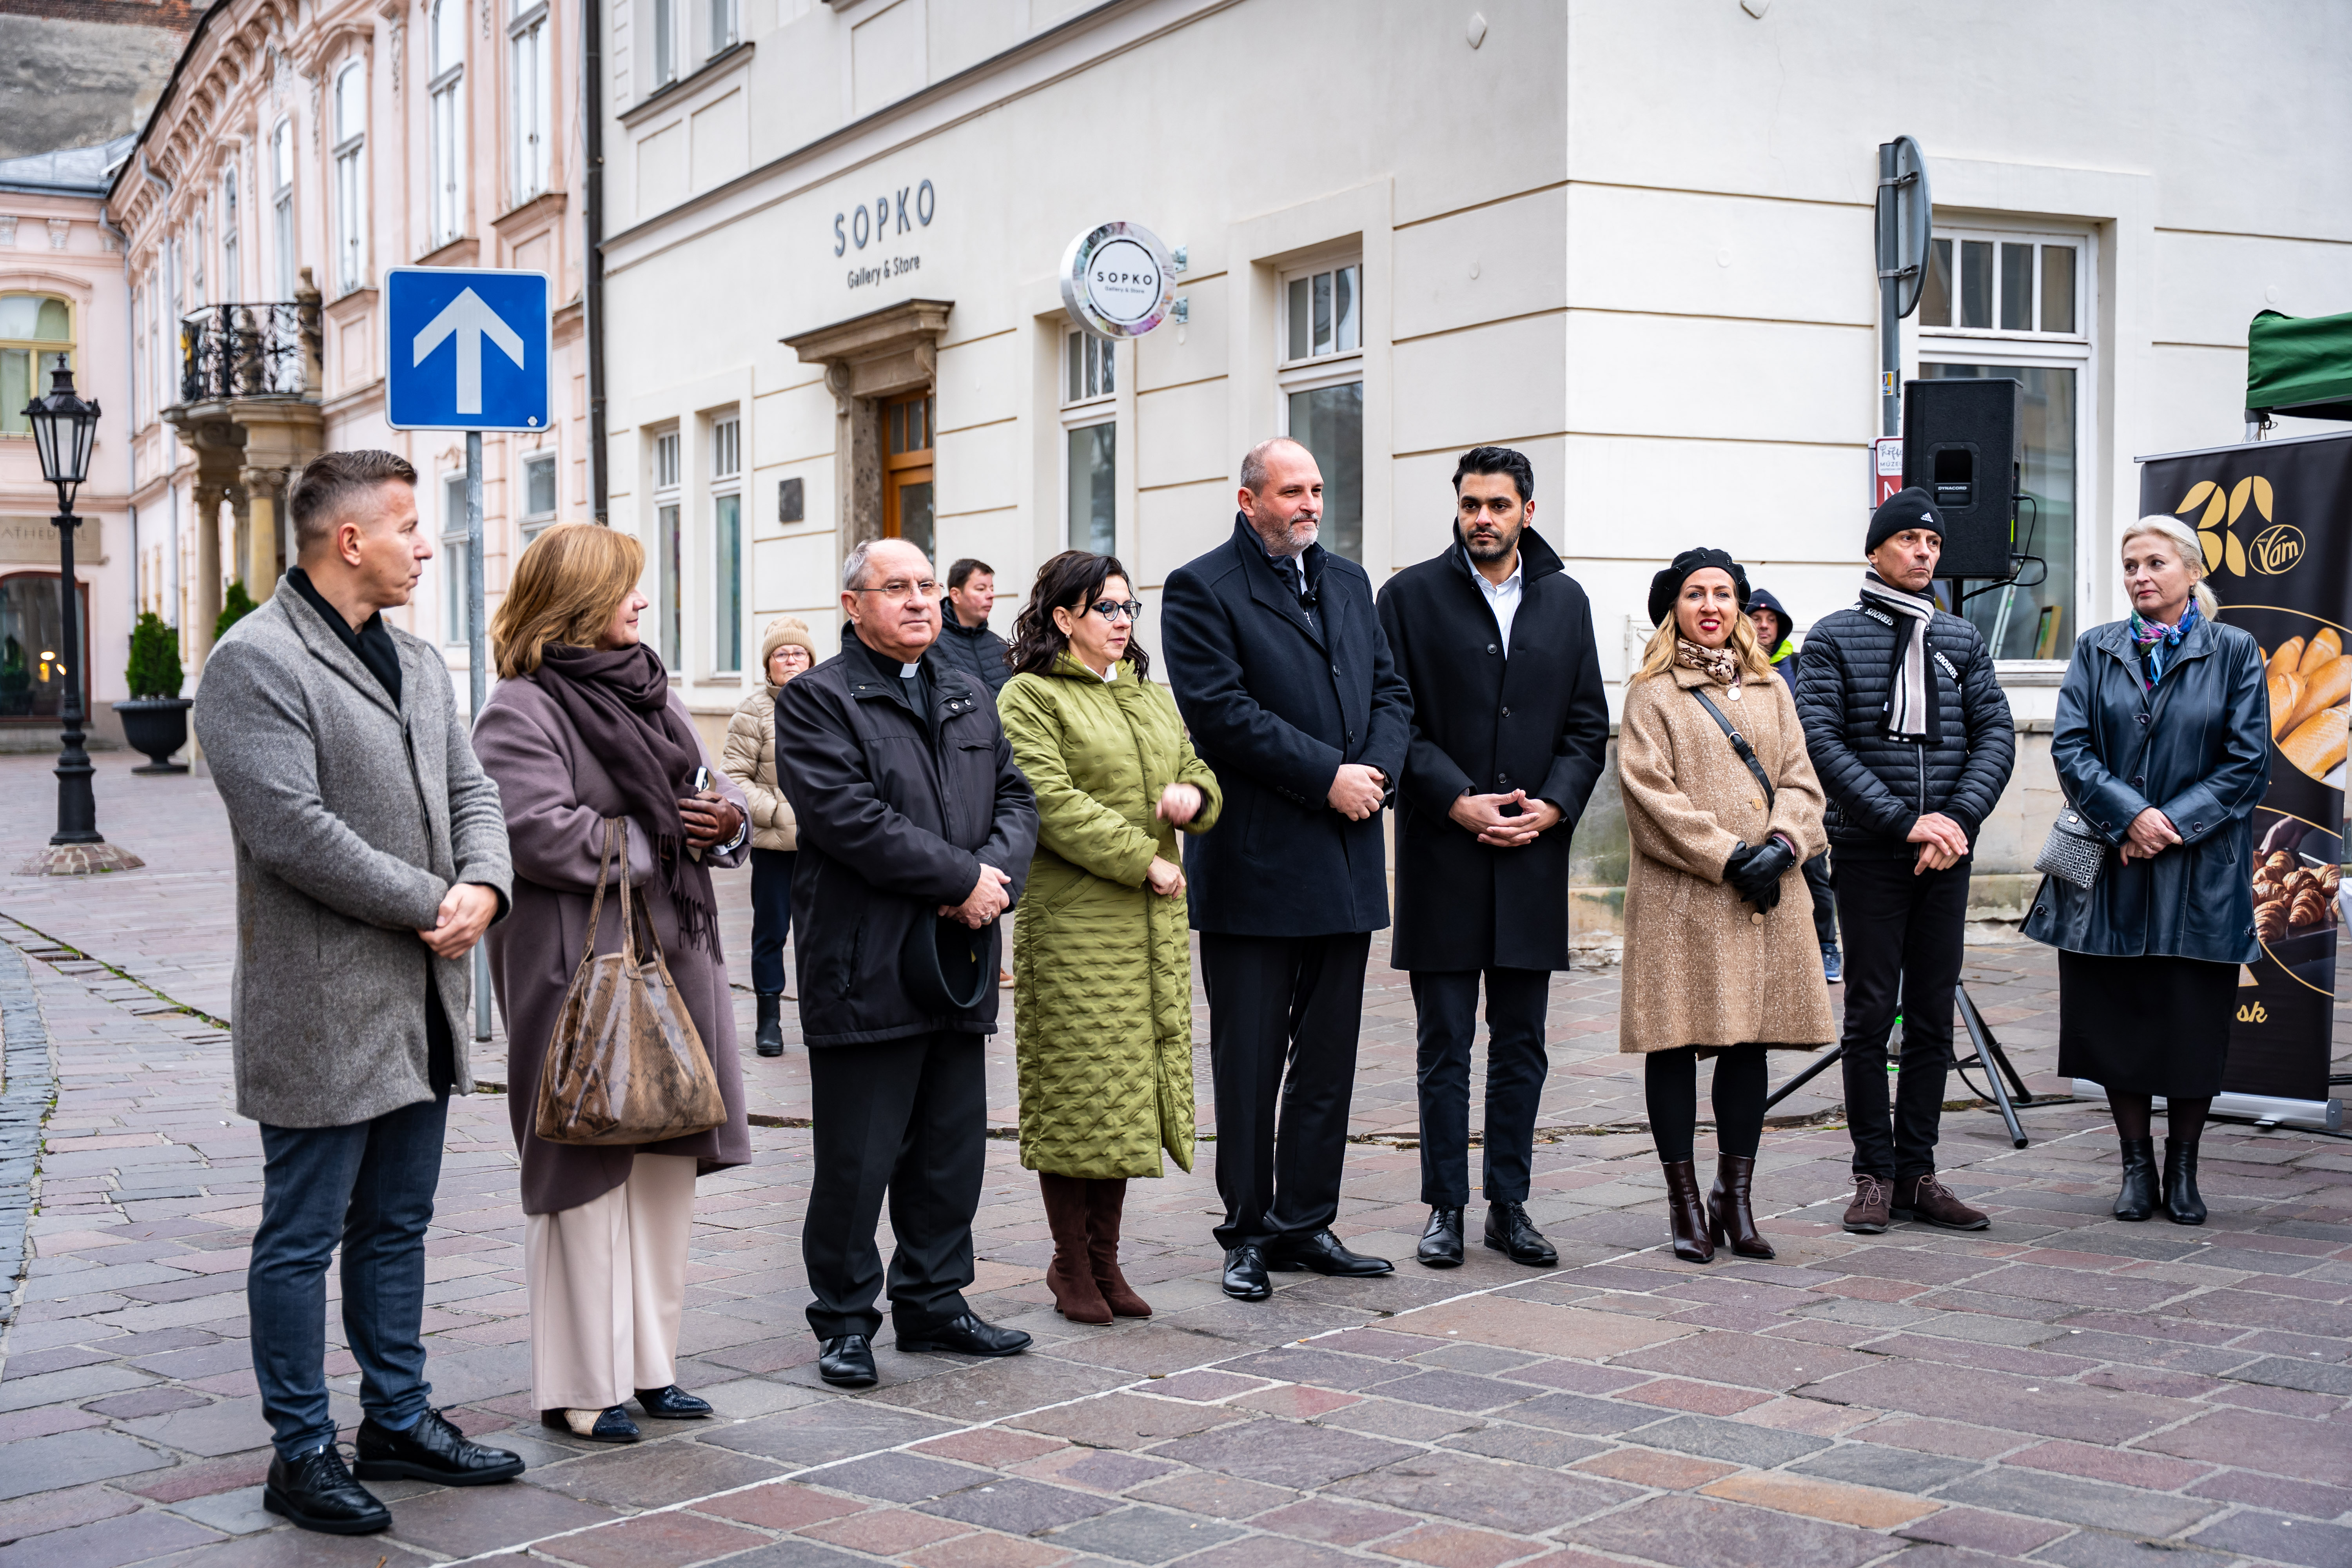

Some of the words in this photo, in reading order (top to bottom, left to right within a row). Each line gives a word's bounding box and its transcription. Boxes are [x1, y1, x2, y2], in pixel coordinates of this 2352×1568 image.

[834, 179, 934, 257] SOPKO
[848, 267, 880, 288] Gallery
[884, 260, 889, 278] &
[893, 256, 919, 275] Store
[1097, 271, 1152, 285] SOPKO
[1865, 608, 1893, 626] SERIOUS
[1934, 652, 1958, 679] SERIOUS
